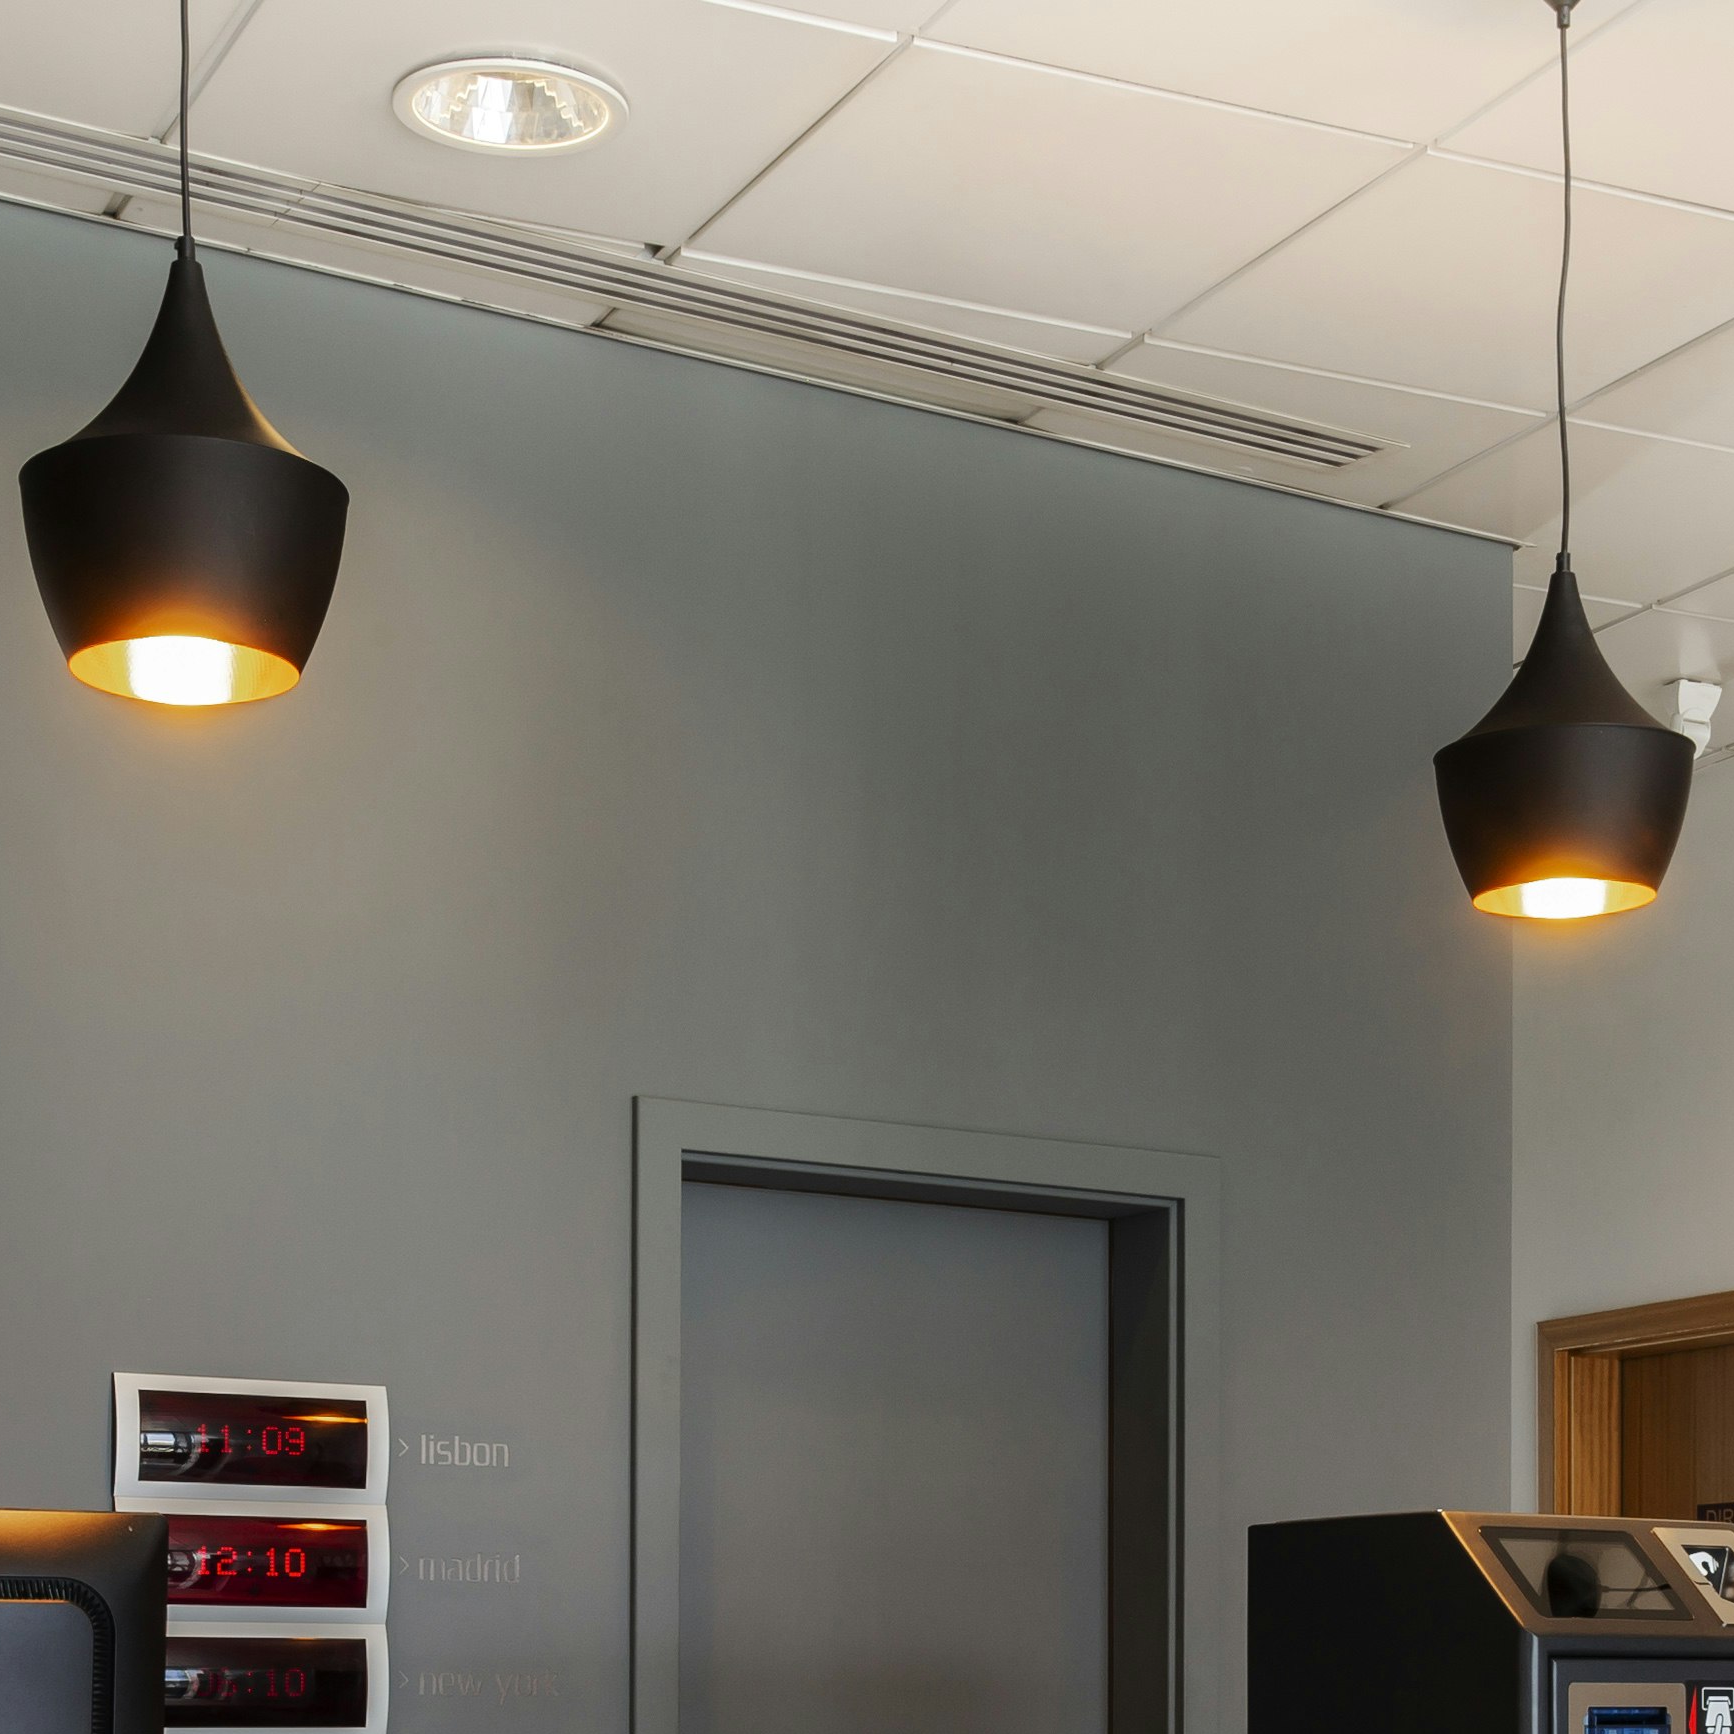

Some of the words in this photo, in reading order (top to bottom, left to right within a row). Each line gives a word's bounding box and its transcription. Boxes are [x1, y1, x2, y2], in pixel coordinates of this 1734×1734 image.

[196, 1423, 305, 1456] 11:09
[420, 1434, 510, 1468] lisbon
[197, 1545, 306, 1577] 12:10
[418, 1553, 521, 1583] madrid
[419, 1672, 482, 1696] new
